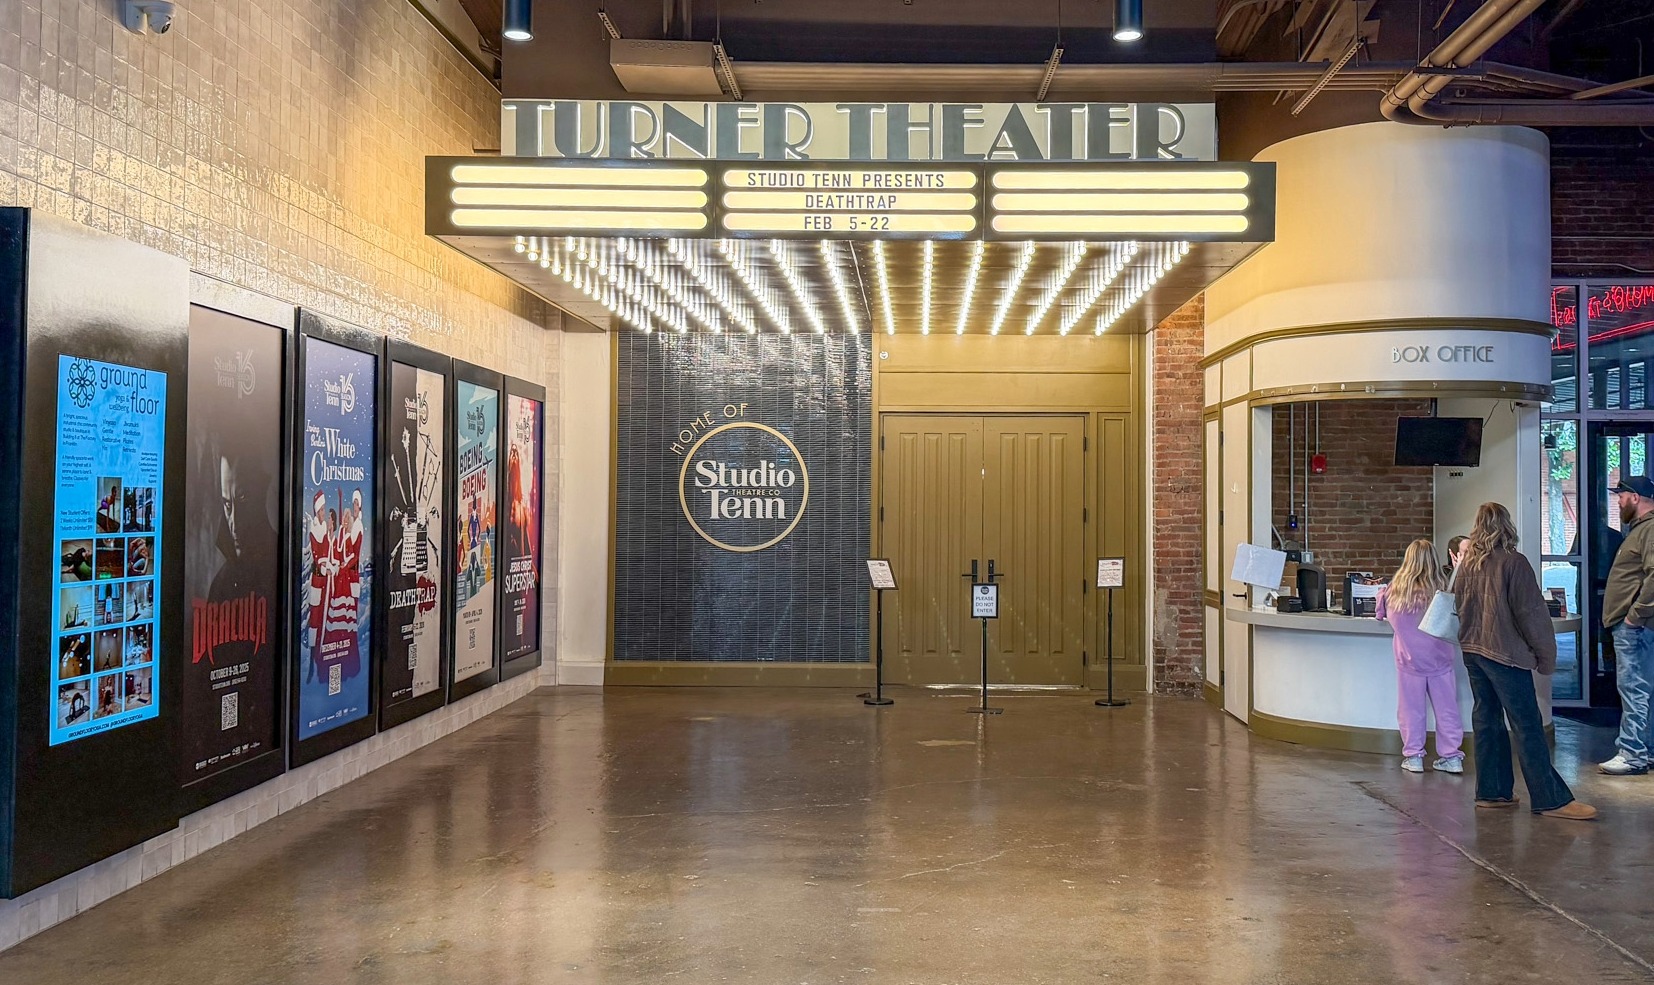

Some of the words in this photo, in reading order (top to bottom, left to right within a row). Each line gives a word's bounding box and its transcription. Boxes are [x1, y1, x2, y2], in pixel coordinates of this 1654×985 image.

[502, 100, 813, 159] TURNER
[836, 102, 1186, 160] THEATER
[748, 172, 805, 187] STUDIO
[813, 173, 852, 189] TENN
[863, 173, 945, 188] PRESENTS
[806, 194, 897, 209] DEATHTRAP
[804, 216, 832, 230] FEB
[850, 216, 889, 230] 5-22
[1392, 346, 1430, 363] BOX
[1437, 345, 1494, 363] OFFICE
[100, 366, 148, 390] ground
[324, 379, 341, 394] Studio
[130, 391, 160, 416] floor
[325, 391, 340, 407] Tenn
[670, 411, 715, 456] HOME
[723, 403, 748, 418] OF
[324, 427, 356, 459] White
[310, 450, 364, 486] Christmas
[460, 442, 483, 476] BOEING
[462, 468, 487, 501] BOEING
[695, 460, 796, 488] Studio
[701, 488, 787, 519] Tenn
[504, 571, 536, 595] SUPERSTAR
[389, 586, 436, 610] DEATHTRAP
[192, 591, 267, 666] DRACULA
